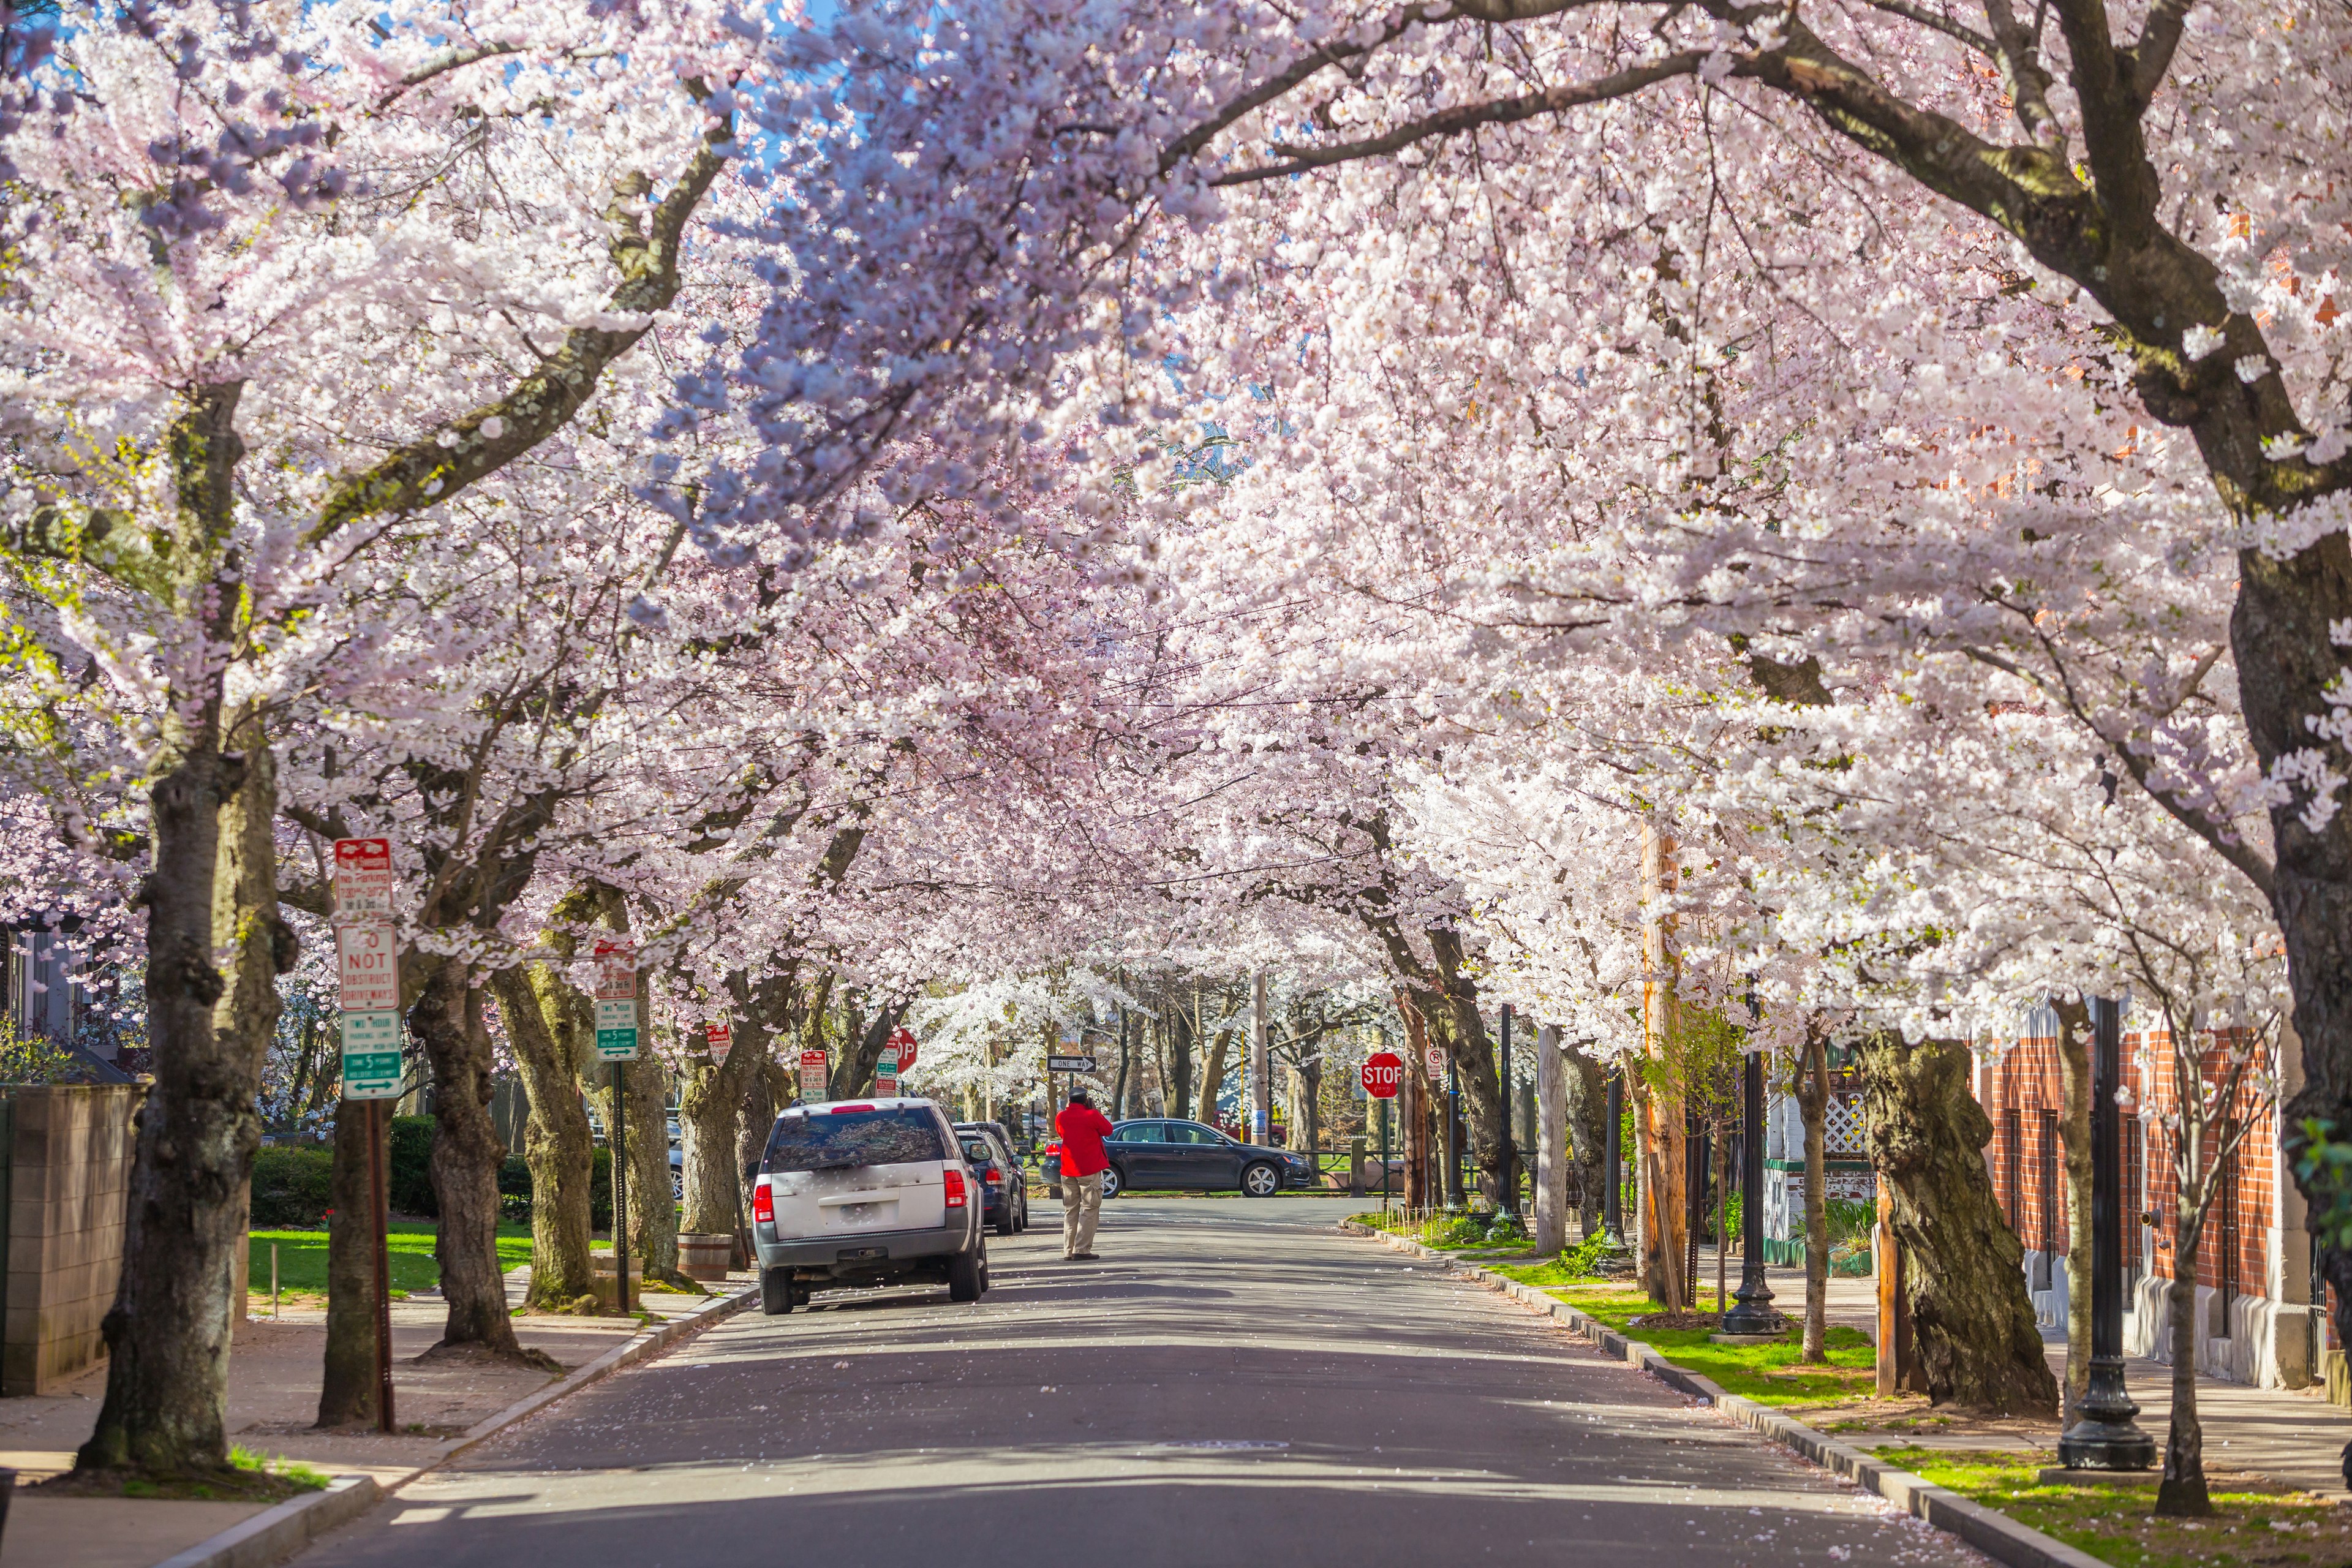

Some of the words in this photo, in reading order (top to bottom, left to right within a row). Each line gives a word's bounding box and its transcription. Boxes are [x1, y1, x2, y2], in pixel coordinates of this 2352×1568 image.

[349, 953, 386, 969] NOT
[344, 973, 392, 985] OBSTRUCT
[344, 989, 394, 1000] DRIVEWAYS
[350, 1019, 366, 1028] TWO
[371, 1017, 391, 1028] HOUR
[612, 1030, 617, 1040] 5
[366, 1055, 374, 1068] 5
